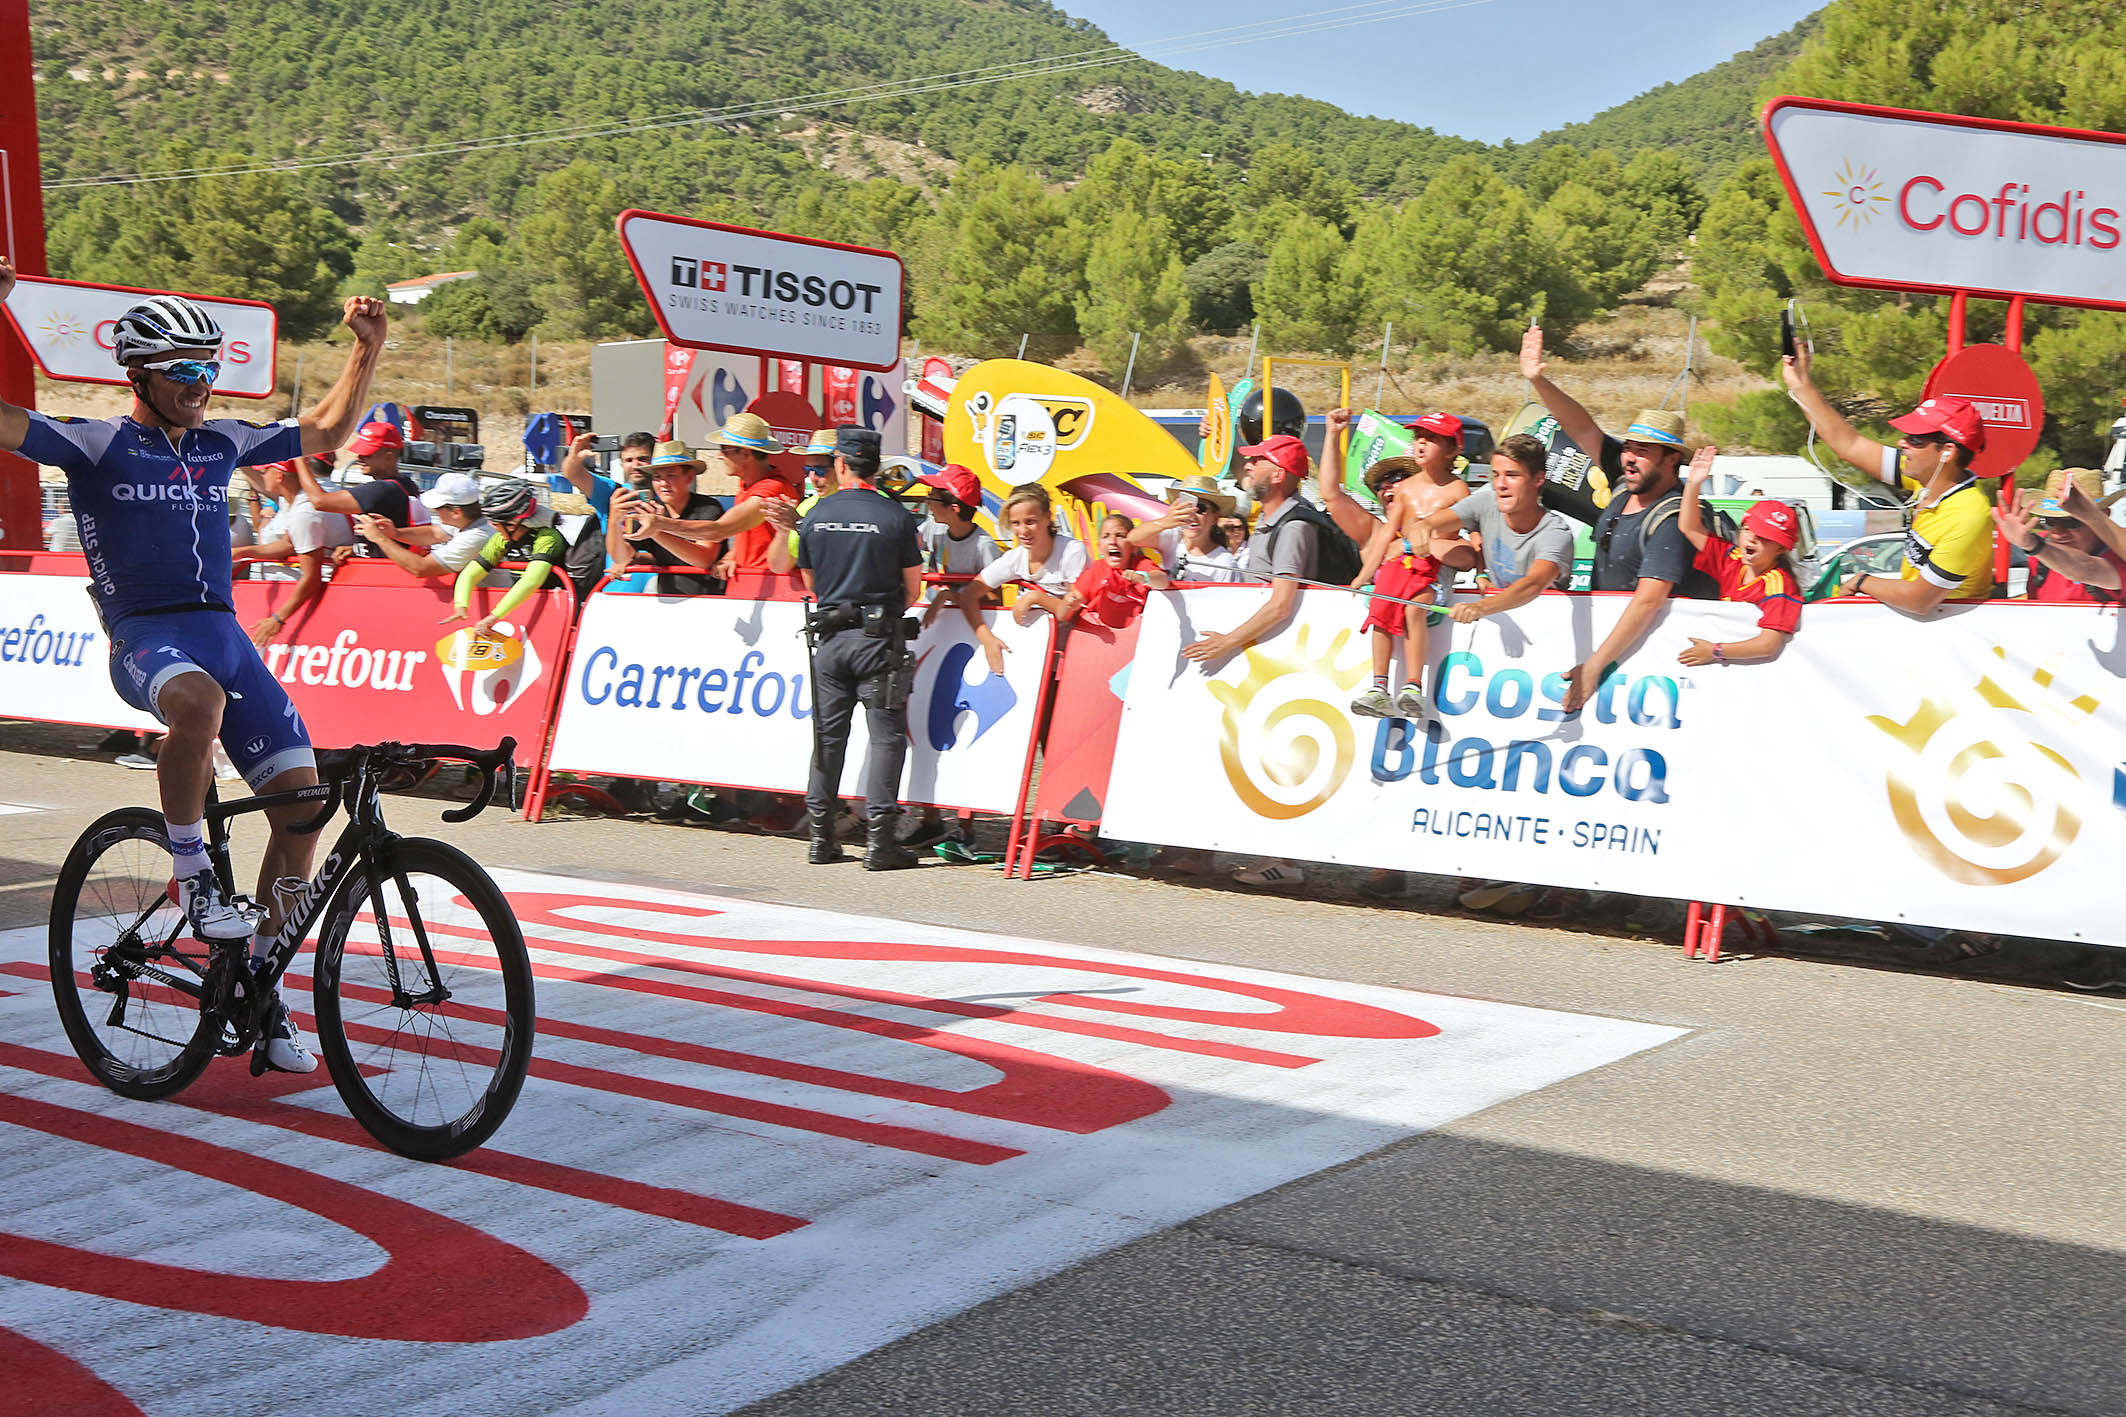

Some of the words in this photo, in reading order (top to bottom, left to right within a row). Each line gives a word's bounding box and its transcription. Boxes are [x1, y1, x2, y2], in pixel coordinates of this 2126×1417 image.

[1900, 175, 2120, 249] Cofidis
[732, 264, 882, 314] TISSOT
[668, 293, 718, 314] SWISS
[724, 302, 796, 324] WATCHES
[802, 312, 846, 331] SINCE
[851, 319, 882, 336] 1853
[187, 452, 224, 463] latexco
[171, 503, 218, 512] FLOORS
[813, 522, 880, 534] POLICIA
[257, 629, 427, 691] rrefour
[581, 646, 814, 719] Carrefou
[1436, 651, 1682, 729] Costa
[1371, 717, 1670, 804] Blanca
[1411, 808, 1549, 845] ALICANTE
[1572, 821, 1662, 856] SPAIN
[264, 851, 343, 976] S-WORKS
[122, 960, 173, 984] SPECIALIZED
